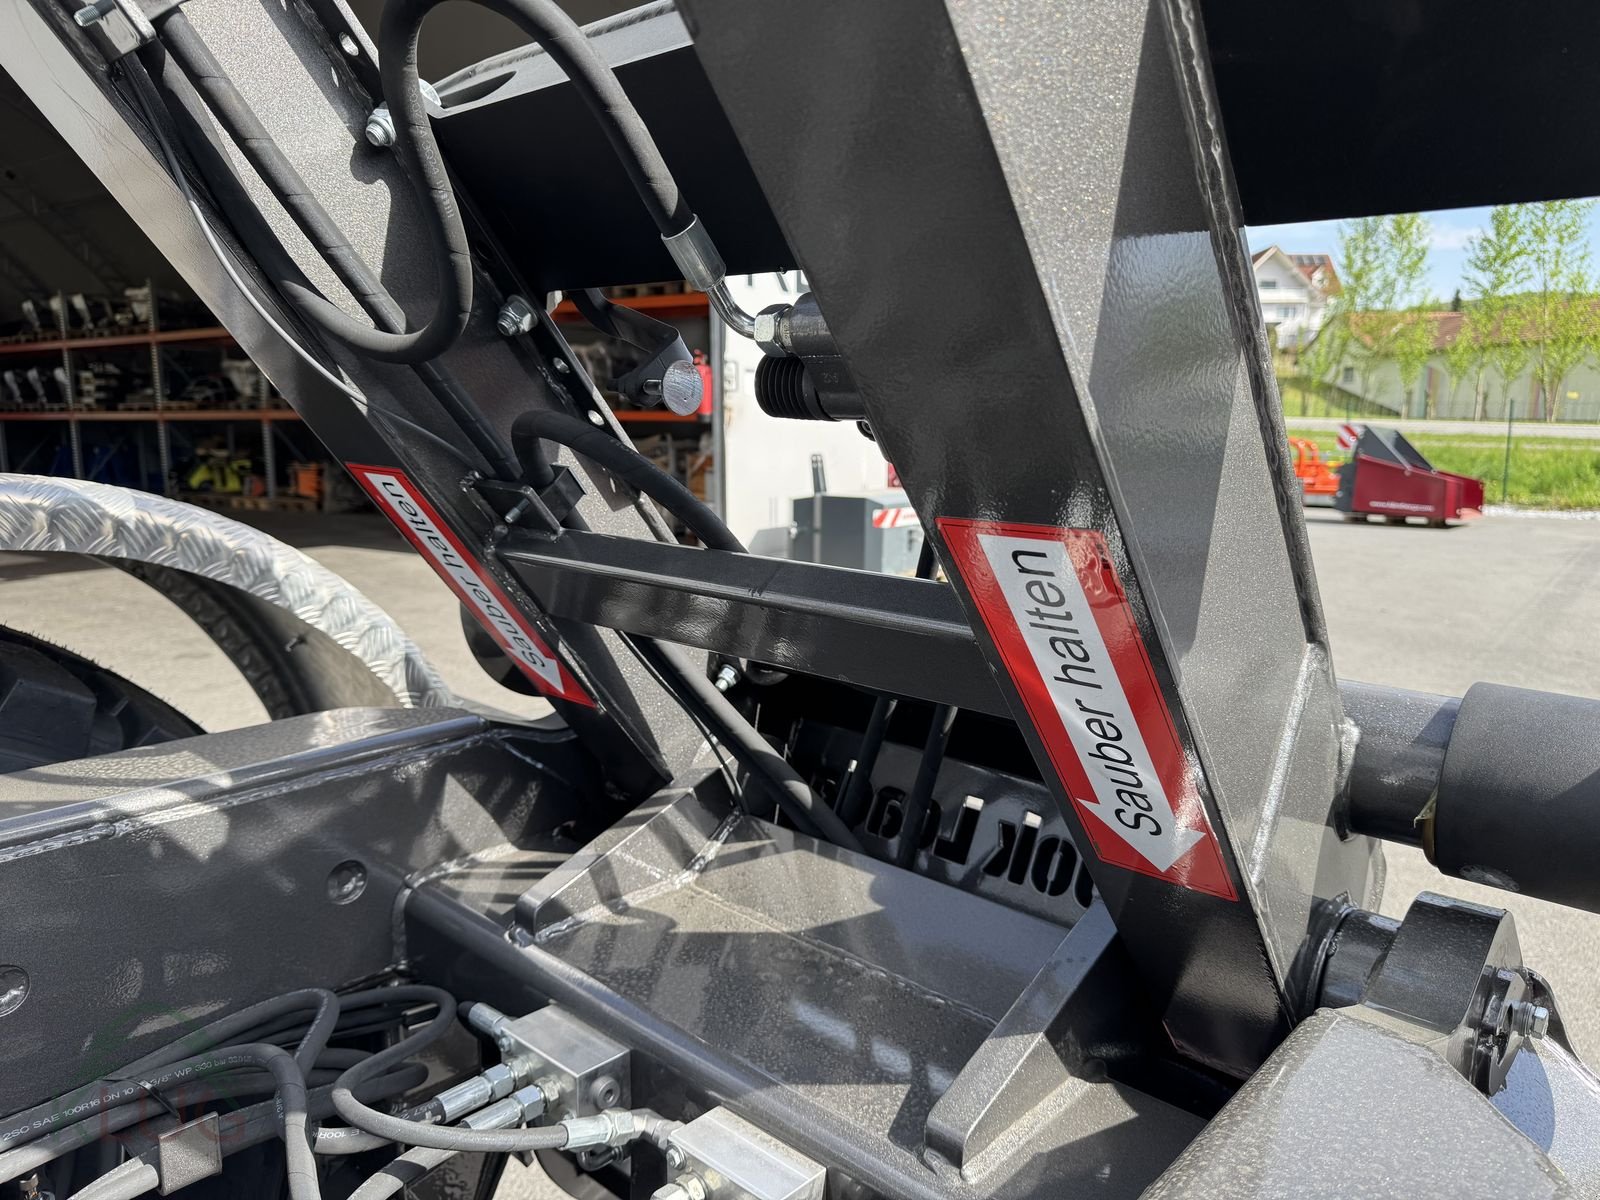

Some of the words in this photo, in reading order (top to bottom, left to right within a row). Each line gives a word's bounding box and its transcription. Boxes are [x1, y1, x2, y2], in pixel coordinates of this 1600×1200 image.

[381, 480, 464, 570] halten
[460, 574, 547, 669] Sauber
[1011, 549, 1103, 690] halten
[1074, 697, 1163, 837] Sauber
[32, 1112, 61, 1129] SAE
[102, 1092, 121, 1104] DN
[122, 1086, 135, 1097] 10
[174, 1067, 193, 1079] WP
